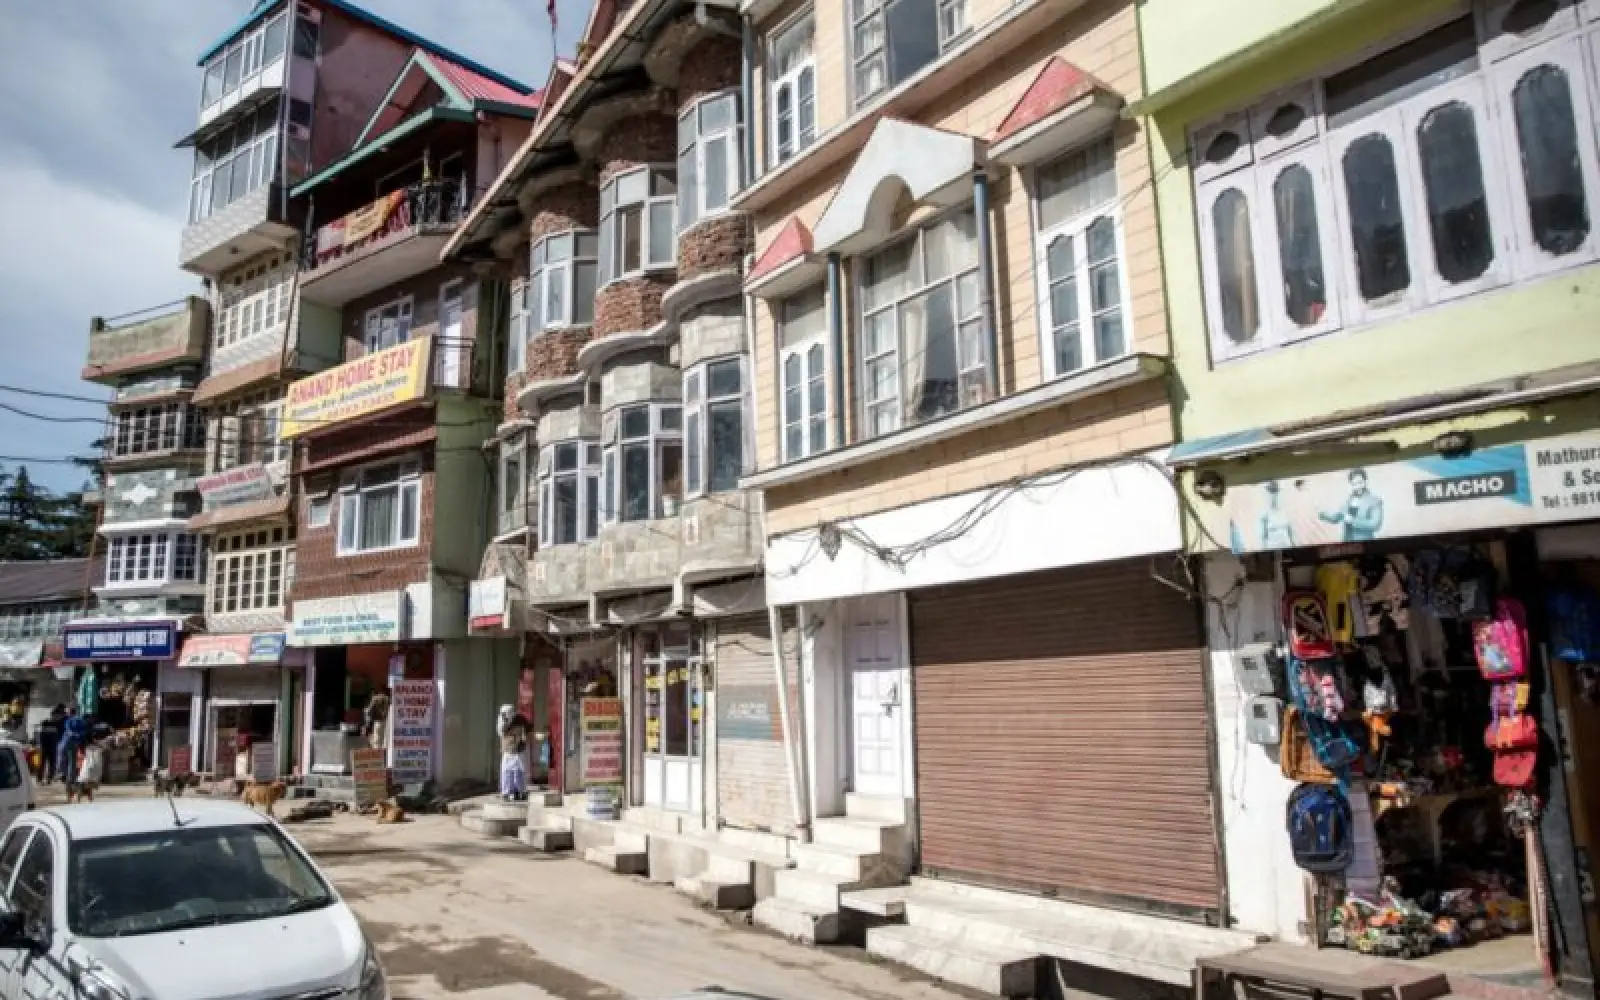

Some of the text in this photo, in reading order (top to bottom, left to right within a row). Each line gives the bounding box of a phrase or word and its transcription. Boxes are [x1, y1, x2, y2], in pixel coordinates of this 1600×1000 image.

[291, 343, 416, 404] ANAND HOME STAY
[1425, 475, 1505, 499] MACHO
[1563, 470, 1575, 487] &
[397, 707, 427, 719] STAY
